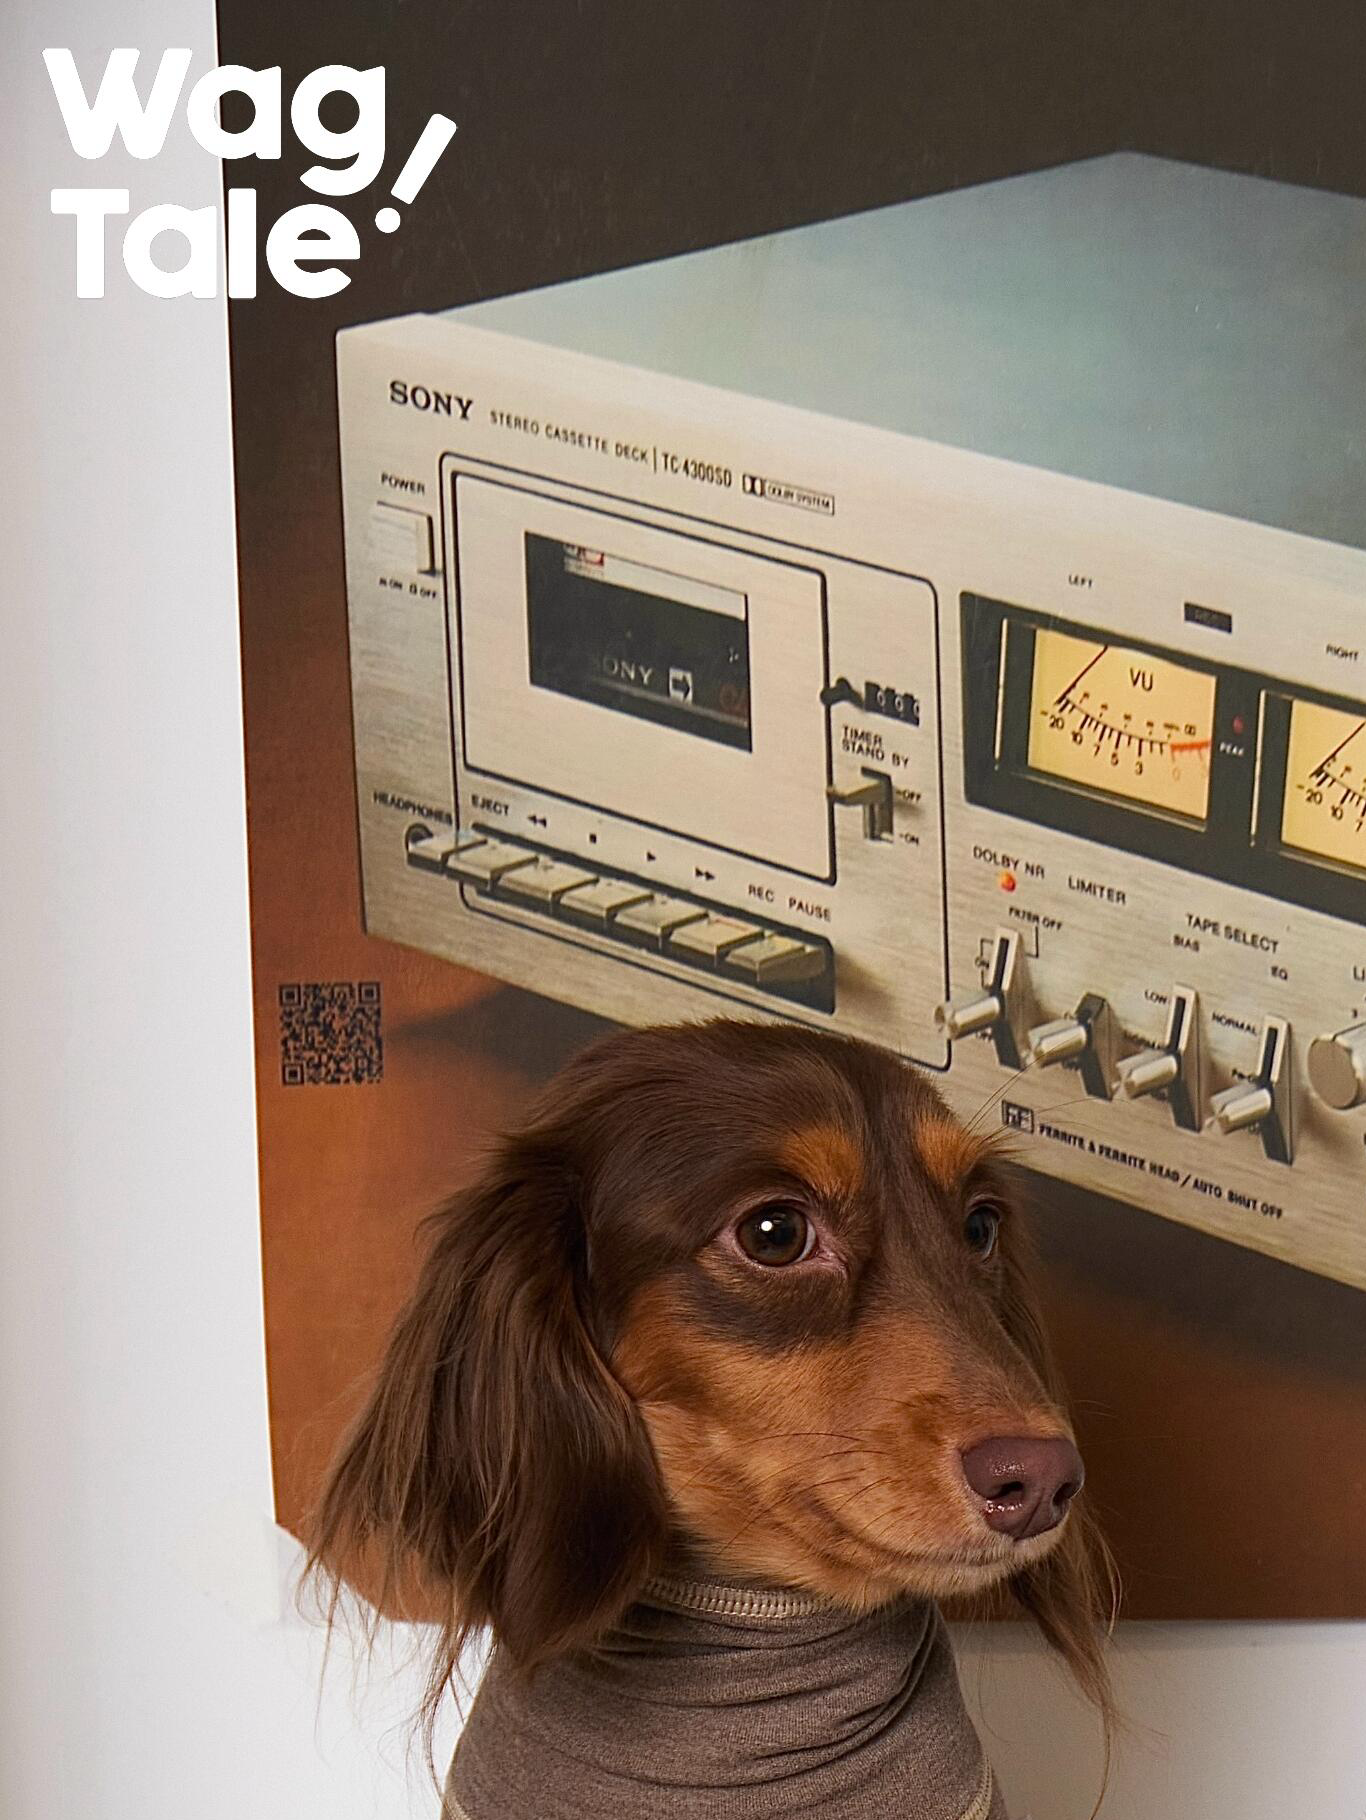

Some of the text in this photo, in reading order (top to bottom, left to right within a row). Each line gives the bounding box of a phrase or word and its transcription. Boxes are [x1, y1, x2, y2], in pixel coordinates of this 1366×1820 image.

[389, 379, 473, 421] SONY
[490, 410, 539, 437] STEREO
[545, 425, 609, 454] CASSETTE
[615, 442, 649, 465] DECK
[380, 472, 426, 496] POWER
[1068, 575, 1093, 589] LEFT
[1326, 644, 1359, 662] RIGHT
[1129, 667, 1154, 692] VU
[843, 725, 882, 747] TIMER
[842, 739, 909, 769] STAND BY
[471, 794, 510, 816] EJECT
[973, 846, 1045, 879] DOLBY NR
[1068, 875, 1126, 905] LIMITER
[748, 884, 833, 923] REC PAUSE
[1173, 934, 1200, 952] BIAS
[1187, 912, 1279, 954] TAPE SELECT
[1270, 965, 1288, 981] EQ
[1144, 989, 1168, 1005] LOW
[1211, 1012, 1257, 1037] NORMAL
[1039, 1123, 1085, 1150] FERRITE
[1098, 1144, 1146, 1171] FERRITE
[1149, 1163, 1180, 1183] HEAD
[1192, 1178, 1223, 1199] AUTO
[1227, 1190, 1258, 1211] SHUT
[1261, 1201, 1283, 1219] OFF
